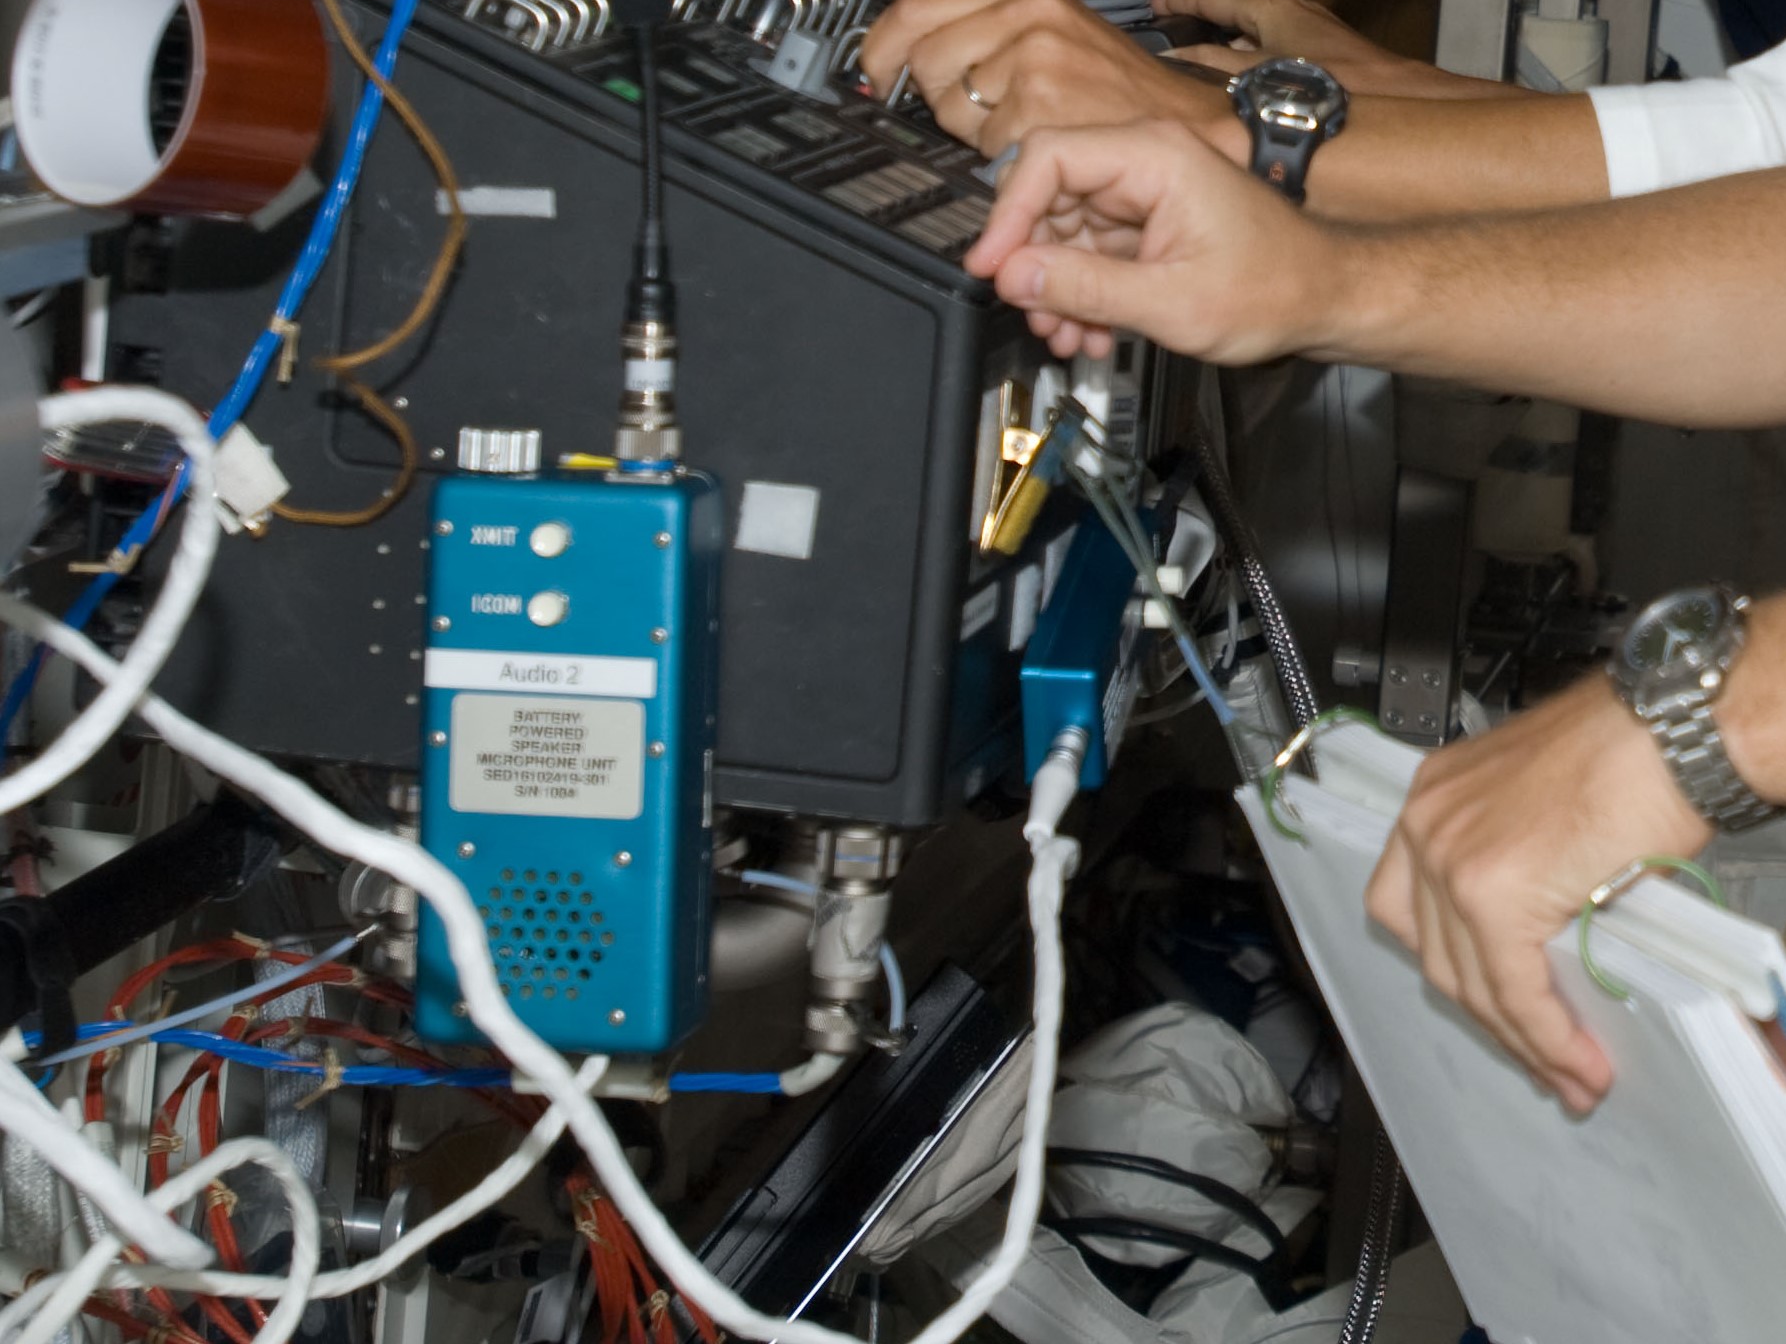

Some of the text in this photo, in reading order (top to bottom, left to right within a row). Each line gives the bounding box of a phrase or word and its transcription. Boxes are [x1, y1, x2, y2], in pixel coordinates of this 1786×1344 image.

[471, 526, 518, 547] XMIT
[471, 594, 522, 615] ICOM
[499, 662, 583, 686] Audio 2
[513, 710, 582, 724] BATTERY
[509, 725, 585, 740] POWERED
[511, 740, 582, 754] SPEAKER
[477, 754, 616, 771] MICROPHONE UNIT
[514, 785, 539, 798] S/N
